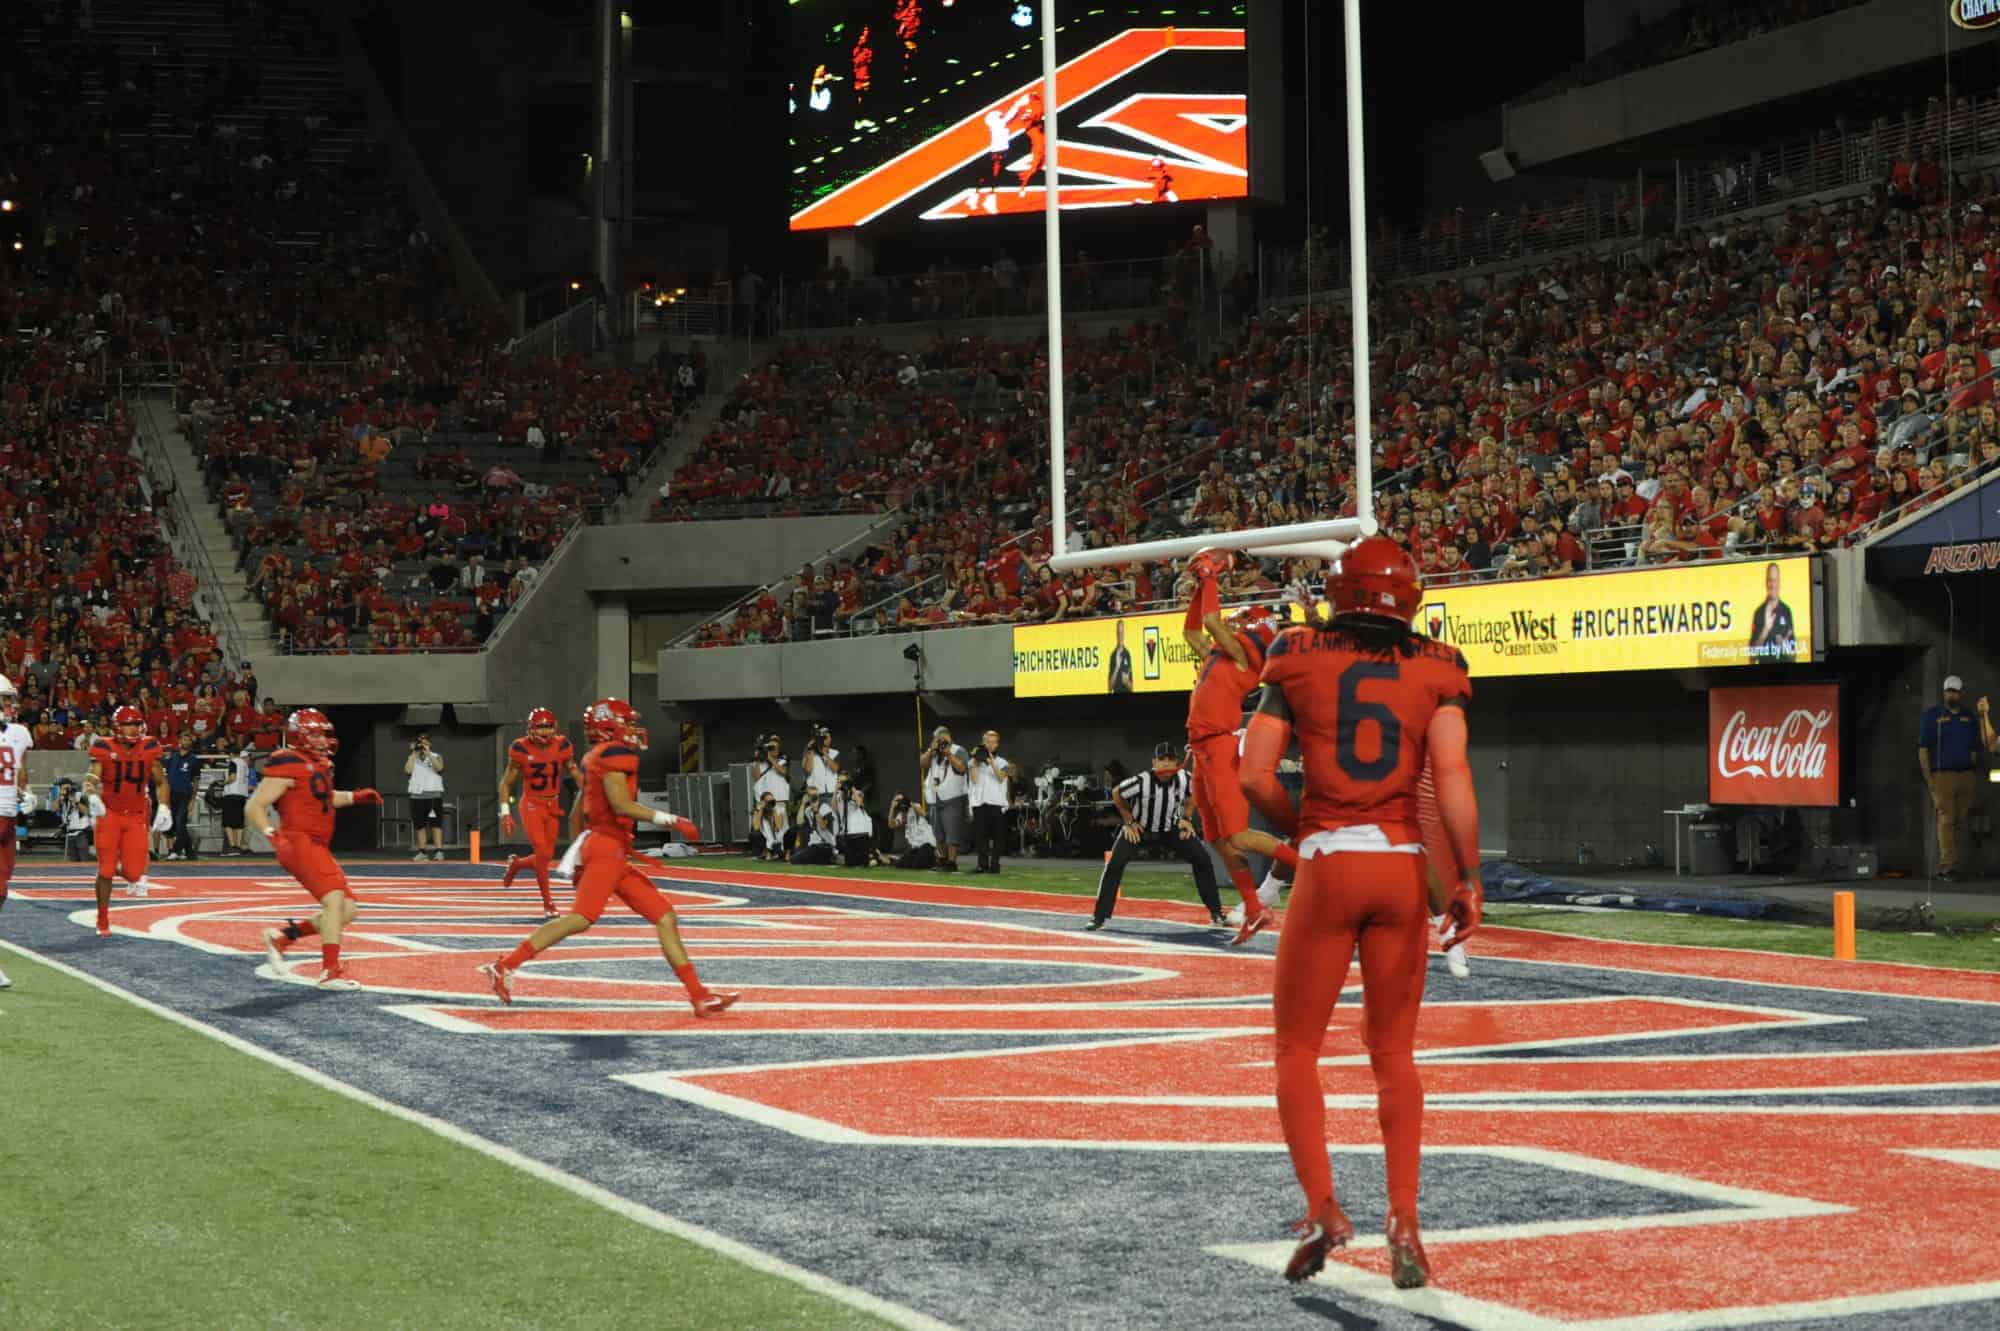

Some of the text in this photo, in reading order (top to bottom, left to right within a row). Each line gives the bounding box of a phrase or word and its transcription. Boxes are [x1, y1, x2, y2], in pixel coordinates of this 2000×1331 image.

[1337, 660, 1401, 782] 6
[1718, 709, 1833, 779] Coca-Cola
[113, 760, 145, 793] 14
[530, 761, 560, 791] 31
